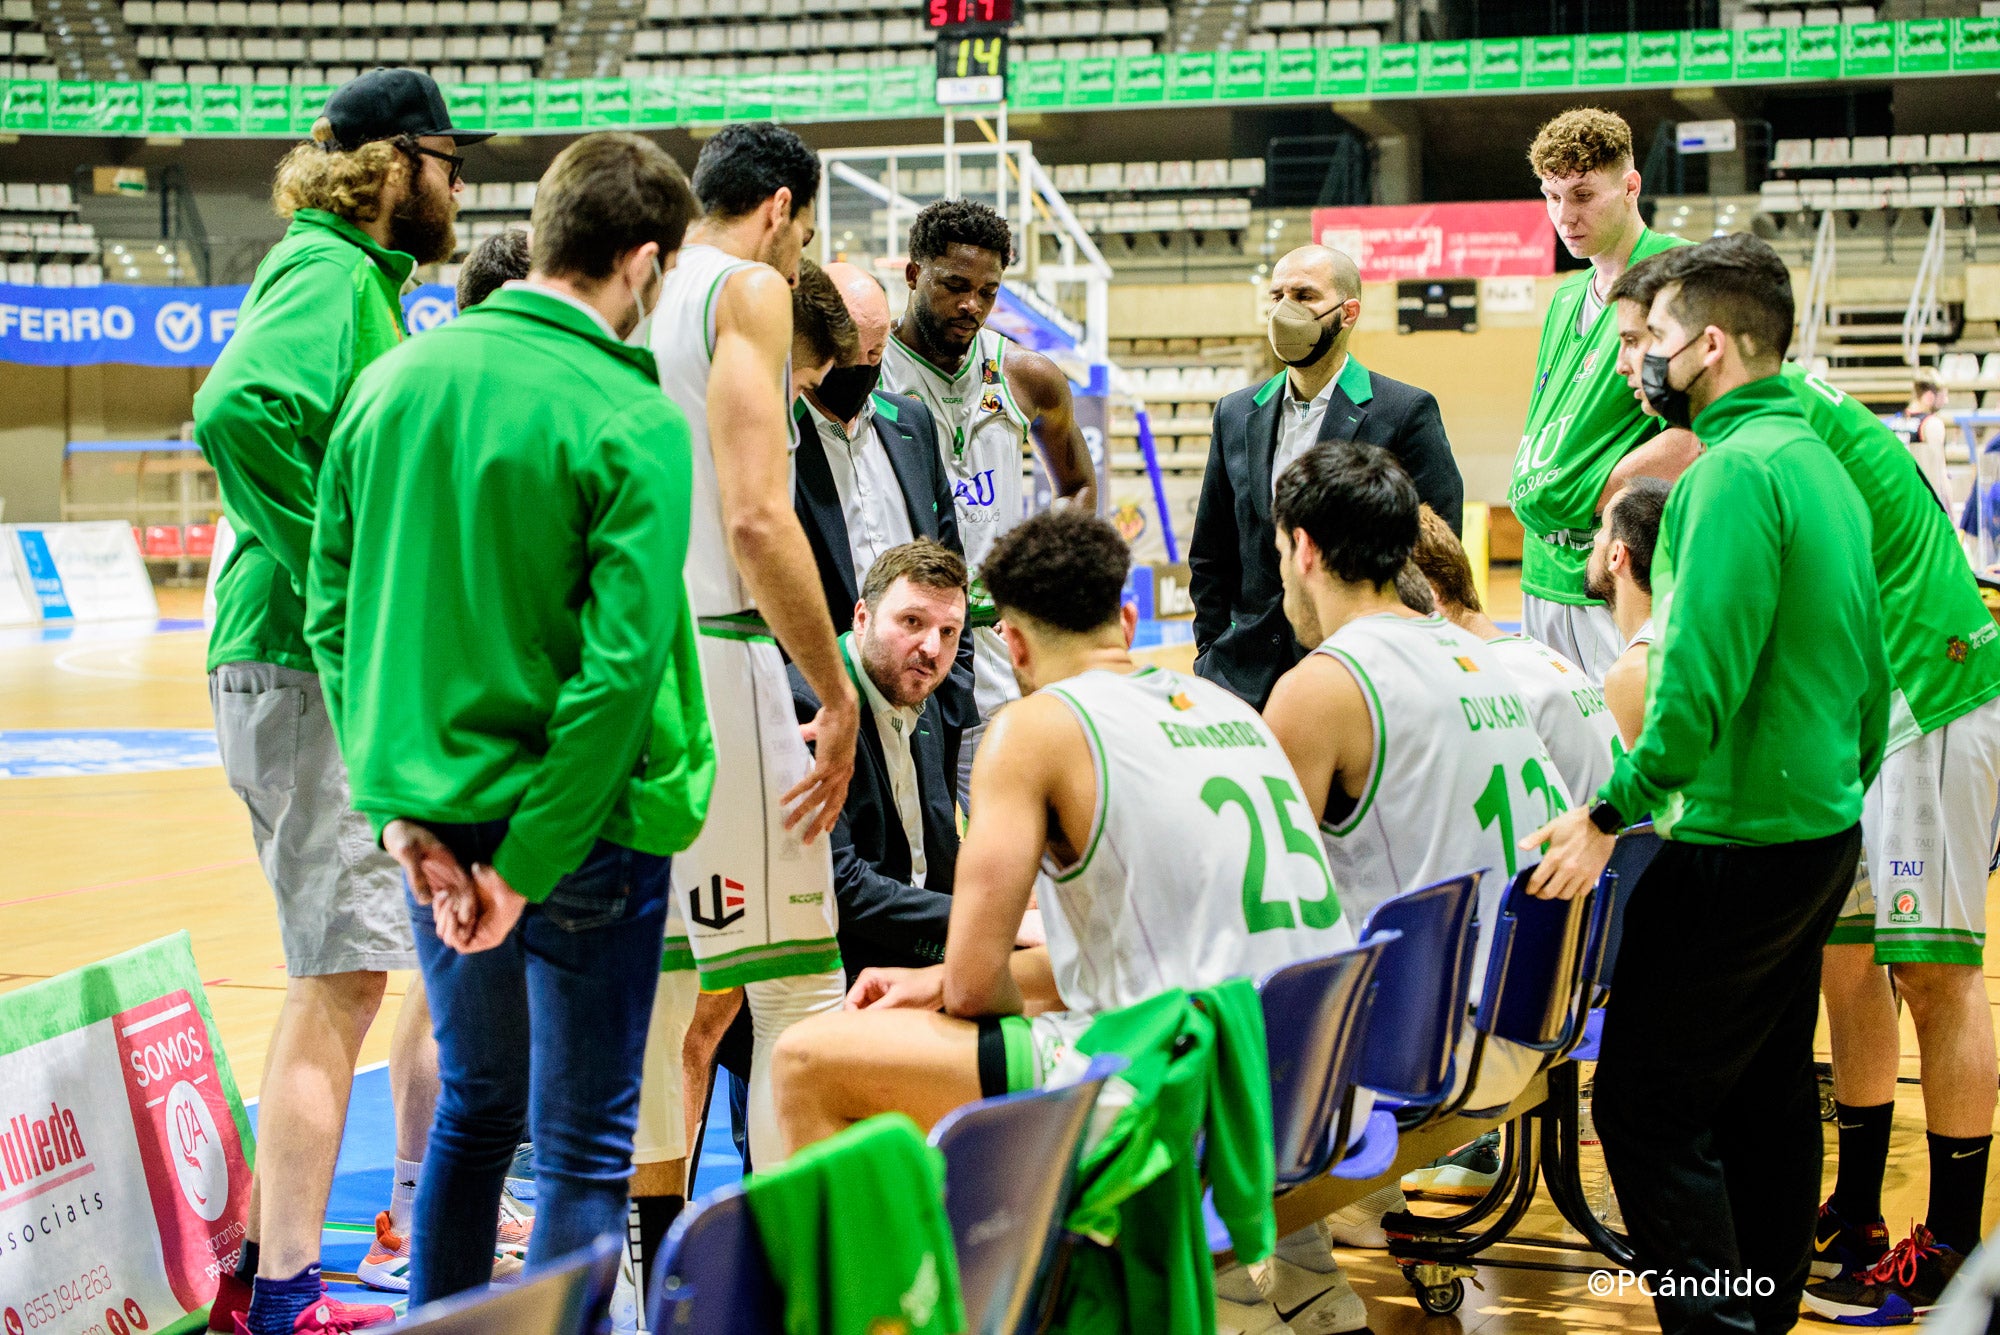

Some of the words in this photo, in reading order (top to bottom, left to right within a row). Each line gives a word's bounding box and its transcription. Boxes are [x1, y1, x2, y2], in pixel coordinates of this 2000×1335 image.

[956, 38, 1001, 77] 14
[948, 469, 995, 507] AU
[1159, 721, 1267, 748] EDWARDS
[1201, 775, 1341, 934] 25
[1890, 861, 1924, 876] TAU
[131, 1026, 203, 1087] SOMOS
[0, 1102, 86, 1191] ulleda
